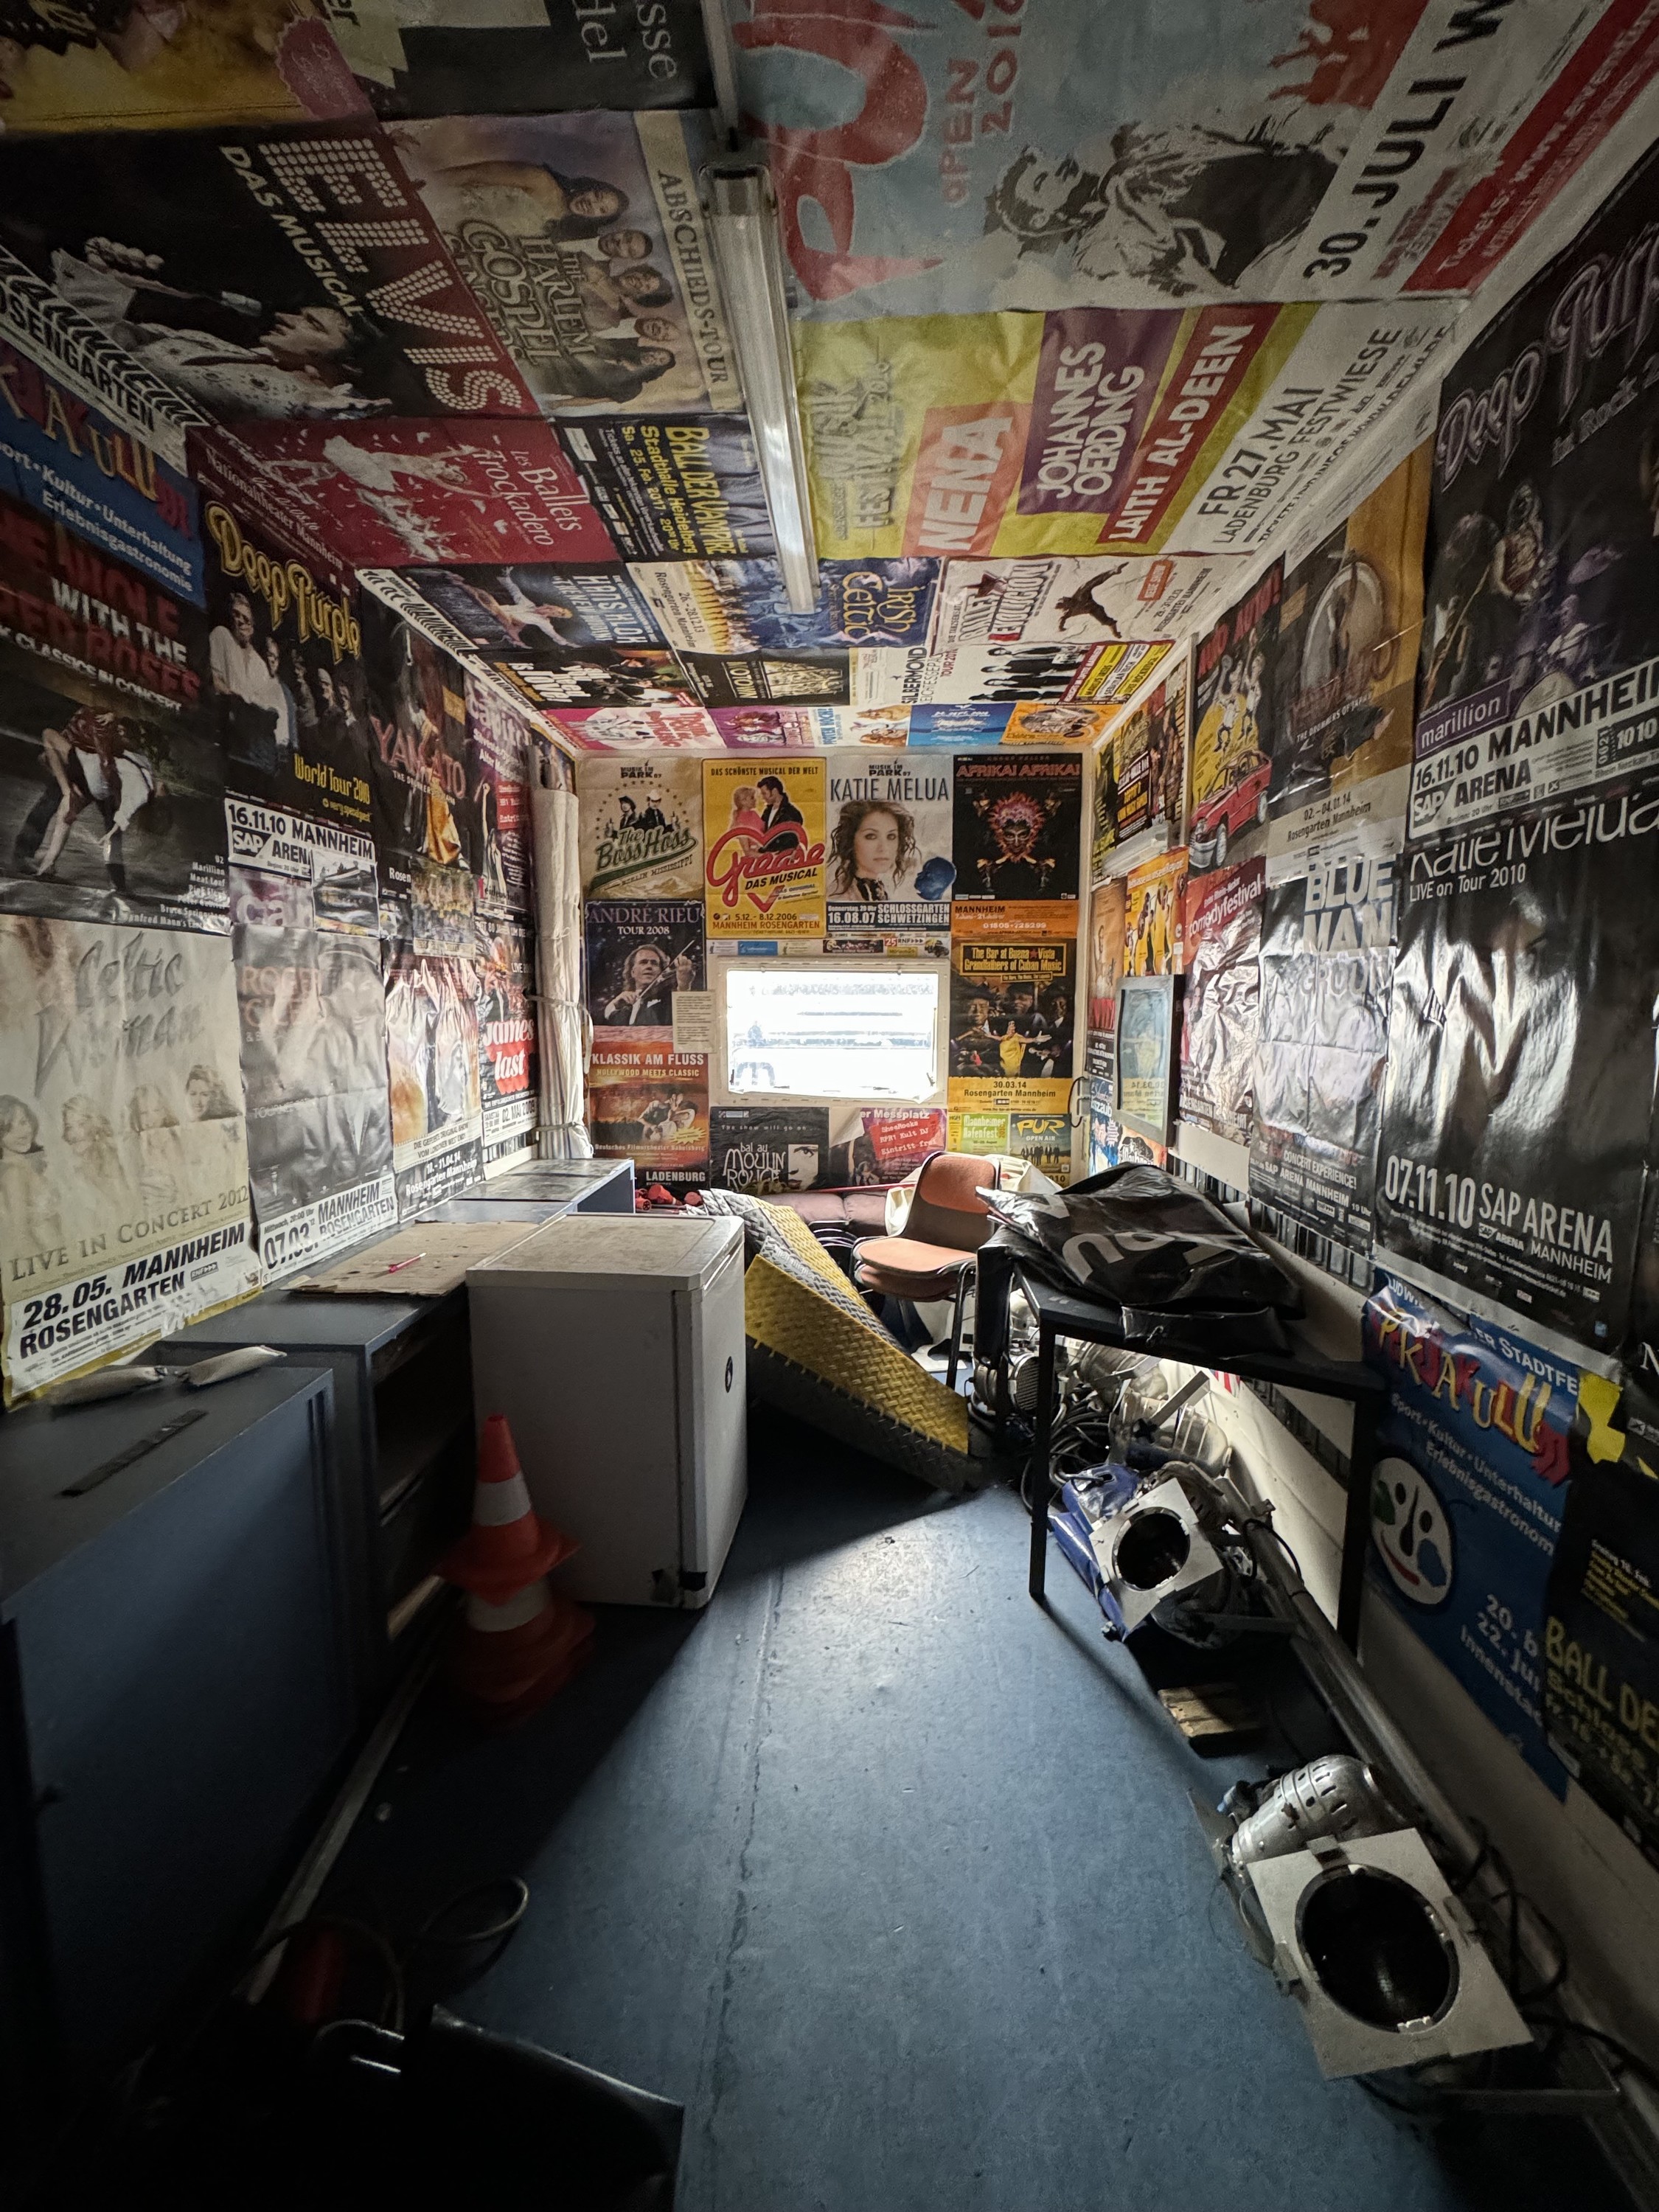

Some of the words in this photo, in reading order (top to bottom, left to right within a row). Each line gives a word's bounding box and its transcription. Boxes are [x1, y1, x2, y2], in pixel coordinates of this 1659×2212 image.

[221, 146, 282, 208] DAS
[273, 213, 366, 318] MUSICAL
[258, 138, 522, 410] ELVIS
[562, 251, 586, 283] THE
[658, 170, 728, 385] ABSCHIEDS-TOUR
[462, 219, 562, 367] GOSPEL
[519, 234, 597, 356] HARLEM
[622, 425, 637, 445] Sa.
[1037, 342, 1107, 499] JOHANNES
[1073, 366, 1145, 495] OERDING
[1109, 476, 1171, 540] LAITH
[1155, 324, 1254, 467] AL-DEEN
[1213, 451, 1301, 544] LADENBURG
[1289, 328, 1402, 447] FESTWIESE
[510, 450, 534, 469] Les
[664, 427, 712, 471] BALL
[473, 449, 554, 547] Trockadero
[518, 467, 591, 532] Ballets
[640, 425, 677, 495] Stadthalle
[667, 497, 698, 554] Heidelberg
[681, 472, 723, 498] DER
[918, 416, 1014, 552] NENA
[1198, 479, 1247, 515] FR
[690, 499, 737, 555] VAMPIRE
[205, 500, 291, 631] Deep
[285, 559, 363, 666] Purple
[655, 571, 681, 619] Rosengarten
[49, 576, 131, 639] WITH
[136, 622, 188, 664] THE
[572, 575, 627, 610] HANS
[603, 613, 648, 644] KLOK
[726, 661, 759, 699] MOTOWN
[1421, 694, 1502, 750] marillion
[293, 753, 327, 789] World
[329, 771, 352, 797] Tour
[711, 768, 724, 776] DAS
[725, 766, 757, 776] SCHÖNSTE
[802, 767, 818, 775] WELT
[830, 778, 886, 802] KATIE
[887, 777, 950, 801] MELUA
[1413, 787, 1447, 821] SAP
[1454, 757, 1533, 808] ARENA
[1415, 743, 1480, 793] 16.11.10
[228, 804, 286, 836] 16.11.10
[291, 818, 375, 860] MANNHEIM
[232, 830, 263, 852] SAP
[1287, 817, 1331, 844] Rosengarten
[1332, 800, 1372, 827] Mannheim
[706, 843, 827, 908] Grease
[745, 877, 767, 891] DAS
[768, 867, 818, 888] MUSICAL
[1304, 854, 1394, 912] BLUE
[1409, 880, 1435, 903] LIVE
[1436, 882, 1453, 897] on
[1458, 873, 1487, 895] Tour
[1489, 862, 1528, 889] 2010
[590, 902, 654, 924] ANDRÉ
[657, 907, 700, 924] RIEU
[617, 926, 645, 935] TOUR
[647, 925, 670, 935] 2008
[759, 913, 798, 921] 8.12.2006
[760, 921, 820, 929] ROSENGARTEN
[827, 912, 876, 924] 16.08.07
[877, 903, 950, 914] SCHLOSSGARTEN
[877, 914, 950, 924] SCHWETZINGEN
[955, 905, 1006, 914] MANNHEIM
[1303, 901, 1392, 953] MAN
[885, 938, 897, 946] 25
[972, 947, 985, 959] The
[986, 947, 999, 959] Bar
[1000, 948, 1008, 959] at
[1009, 948, 1030, 959] Buena
[1037, 947, 1056, 959] Vista
[964, 959, 1009, 971] Grandfathers
[1010, 959, 1018, 970] of
[1018, 959, 1040, 971] Cuban
[1040, 960, 1062, 971] Music
[495, 1049, 526, 1081] last
[592, 1054, 641, 1065] KLASSIK
[645, 1054, 664, 1065] AM
[667, 1054, 704, 1065] FLUSS
[597, 1069, 640, 1077] HOLLYWOOD
[642, 1069, 667, 1077] MEETS
[669, 1068, 700, 1077] CLASSIC
[964, 1089, 1013, 1098] Rosengarten
[1015, 1089, 1056, 1097] Mannheim
[993, 1081, 1027, 1089] 30.03.14
[873, 1110, 931, 1121] Messplatz
[963, 1115, 1006, 1127] Mannheimer
[1016, 1119, 1065, 1137] PUR
[722, 1147, 786, 1177] MOULIN
[740, 1142, 754, 1153] bal
[757, 1143, 768, 1153] au
[1283, 1150, 1312, 1169] CONCERT
[405, 1172, 447, 1196] Rosengarten
[446, 1158, 478, 1180] Mannheim
[646, 1171, 706, 1183] LADENBURG
[1264, 1160, 1279, 1175] SAP
[1279, 1166, 1304, 1186] ARENA
[1305, 1178, 1350, 1208] MANNHEIM
[317, 1180, 380, 1225] MANNHEIM
[319, 1196, 395, 1239] ROSENGARTEN
[1384, 1154, 1476, 1229] 07.11.10
[1478, 1182, 1521, 1227] SAP
[1522, 1197, 1613, 1263] ARENA
[7, 1248, 70, 1283] LIVE
[77, 1232, 107, 1258] IN
[116, 1203, 211, 1245] CONCERT
[217, 1184, 249, 1210] 2012
[23, 1280, 113, 1330] 28.05.
[122, 1222, 246, 1290] MANNHEIM
[1495, 1232, 1525, 1251] ARENA
[1530, 1239, 1613, 1284] MANNHEIM
[18, 1270, 187, 1360] ROSENGARTEN
[1545, 1615, 1615, 1713] BALL
